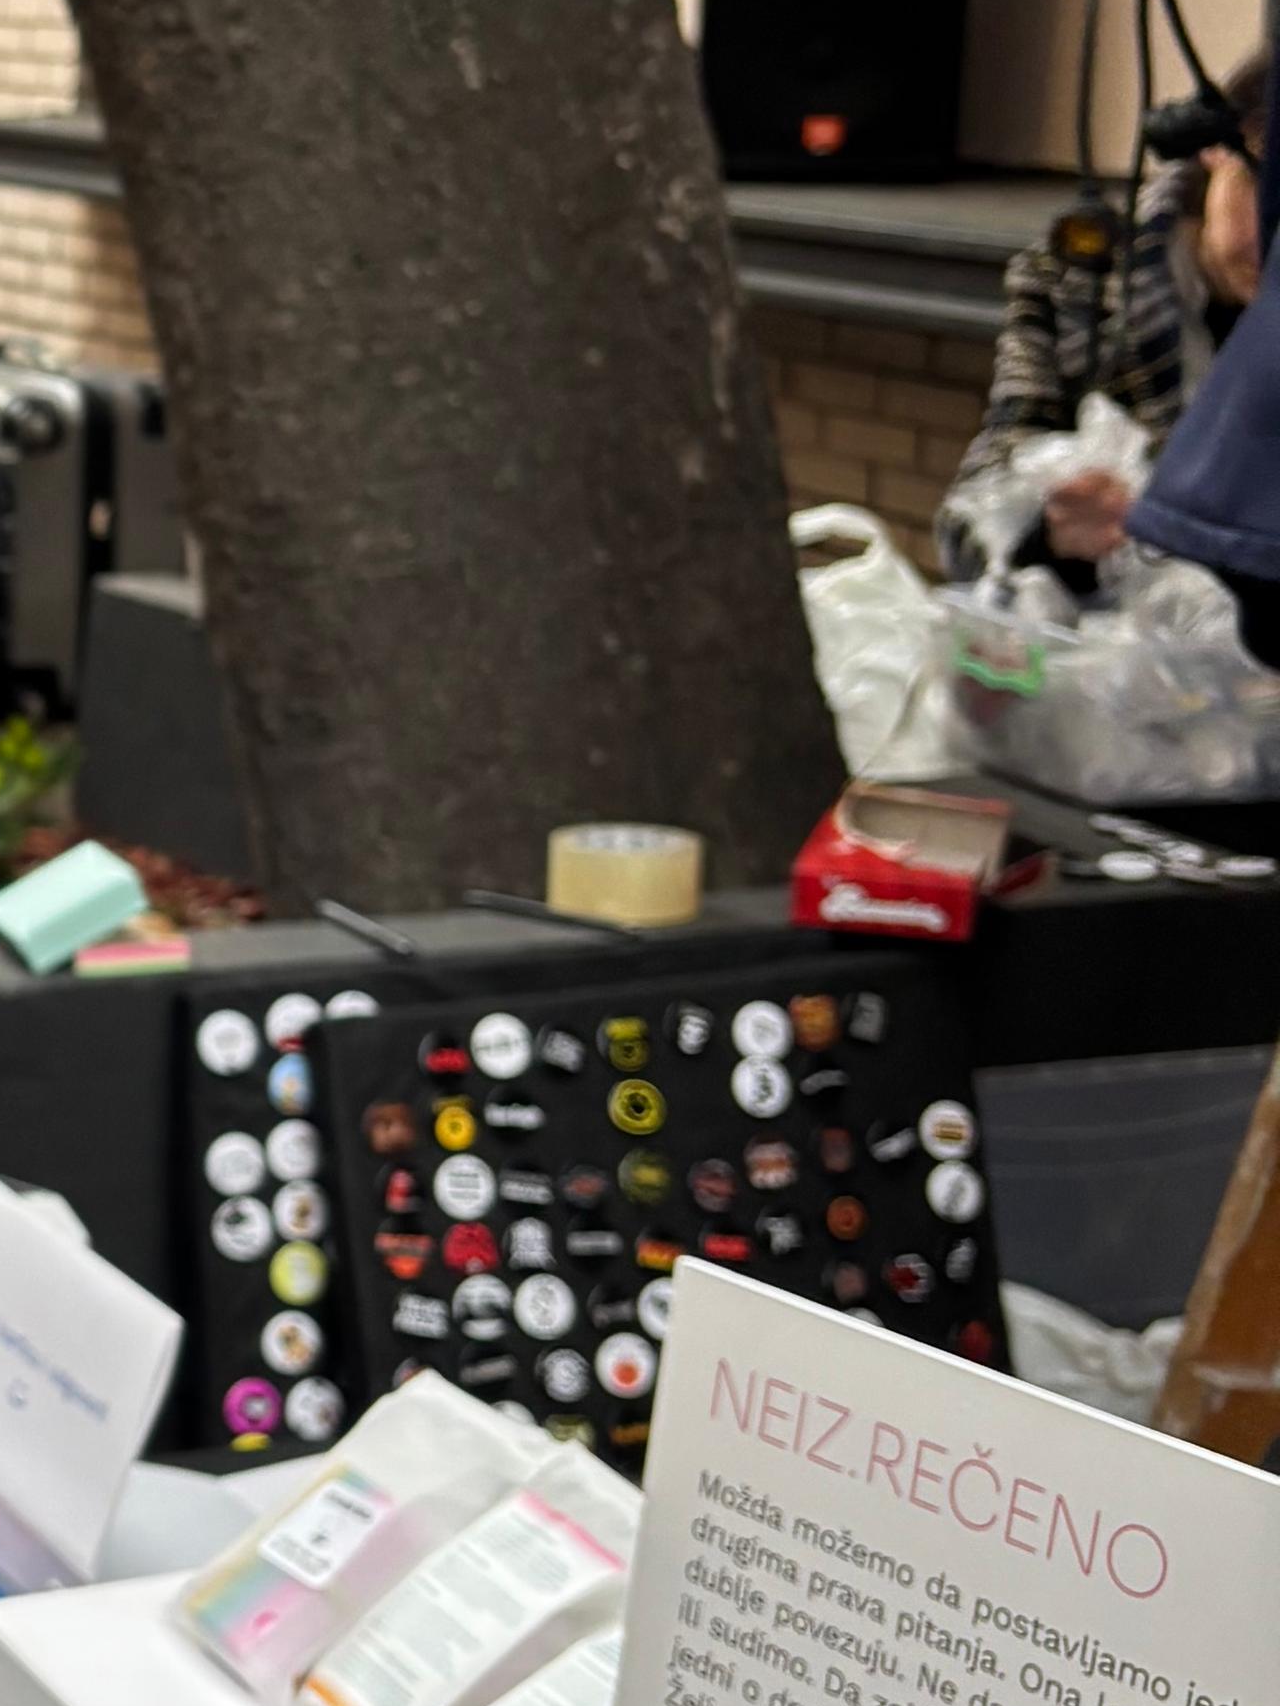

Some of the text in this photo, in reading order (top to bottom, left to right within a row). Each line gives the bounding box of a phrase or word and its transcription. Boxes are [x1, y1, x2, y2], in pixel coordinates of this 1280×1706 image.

[709, 1357, 1168, 1599] NEIZ.REČENO
[678, 1593, 703, 1629] ili
[708, 1614, 814, 1686] sudimo.
[683, 1556, 765, 1614] dublje
[774, 1601, 905, 1681] povezuju.
[917, 1663, 957, 1705] Ne
[691, 1513, 799, 1584] drugima
[808, 1570, 886, 1625] prava
[896, 1610, 1005, 1680] pitanja.
[699, 1469, 783, 1532] Možda
[792, 1517, 914, 1588] možemo
[925, 1572, 961, 1610] da
[972, 1597, 1172, 1701] postavljamo
[667, 1635, 735, 1691] jedni
[741, 1679, 762, 1702] o
